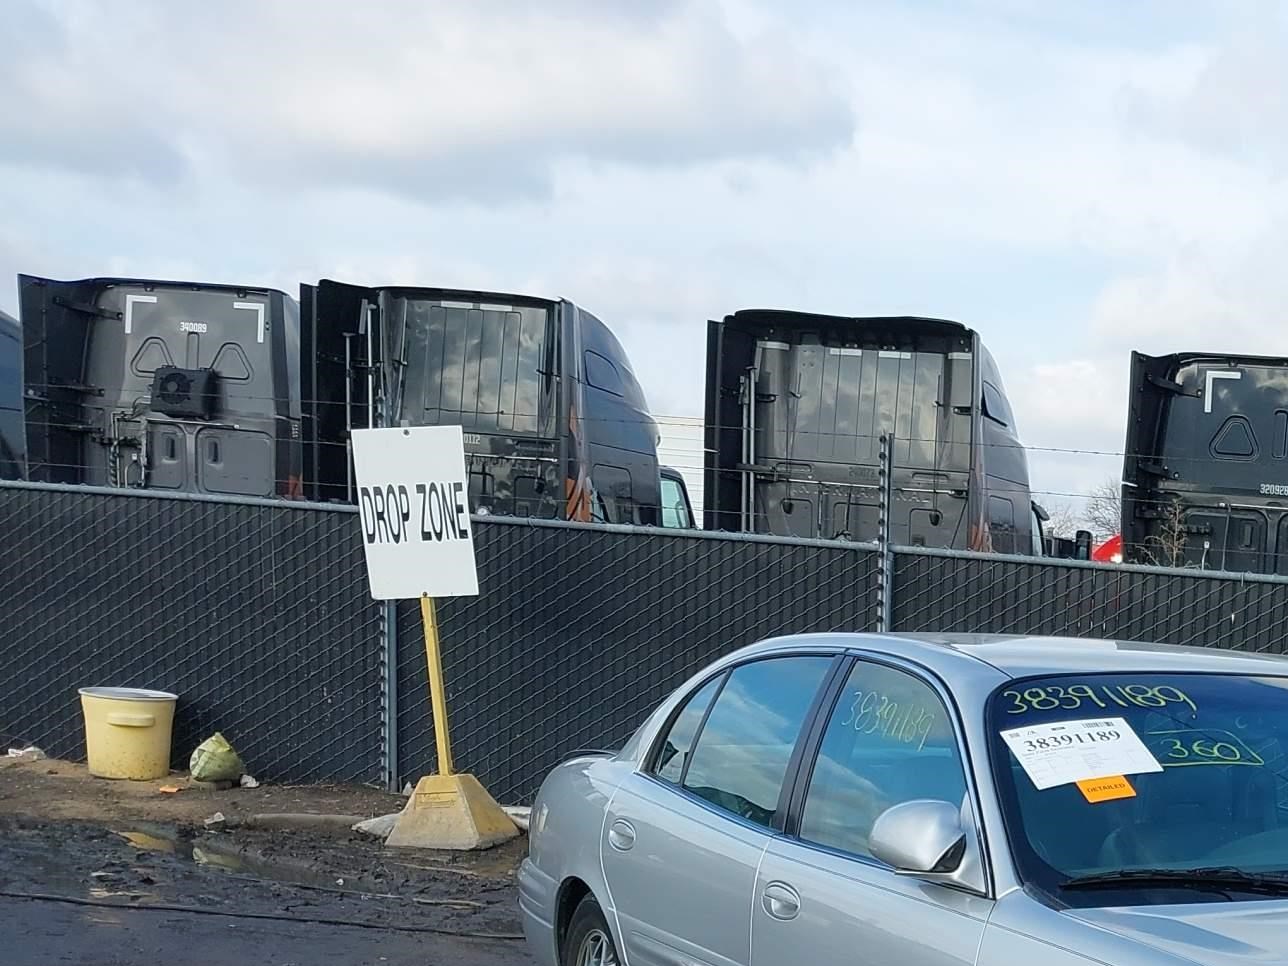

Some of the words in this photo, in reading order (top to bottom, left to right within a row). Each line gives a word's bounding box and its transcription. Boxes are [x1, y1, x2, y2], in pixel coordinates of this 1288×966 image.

[360, 483, 411, 544] DROP
[415, 481, 469, 542] ZONE
[1003, 684, 1197, 714] 38391189
[1023, 729, 1121, 752] 38391189
[1161, 737, 1241, 761] 360
[1086, 782, 1127, 794] DETAILED
